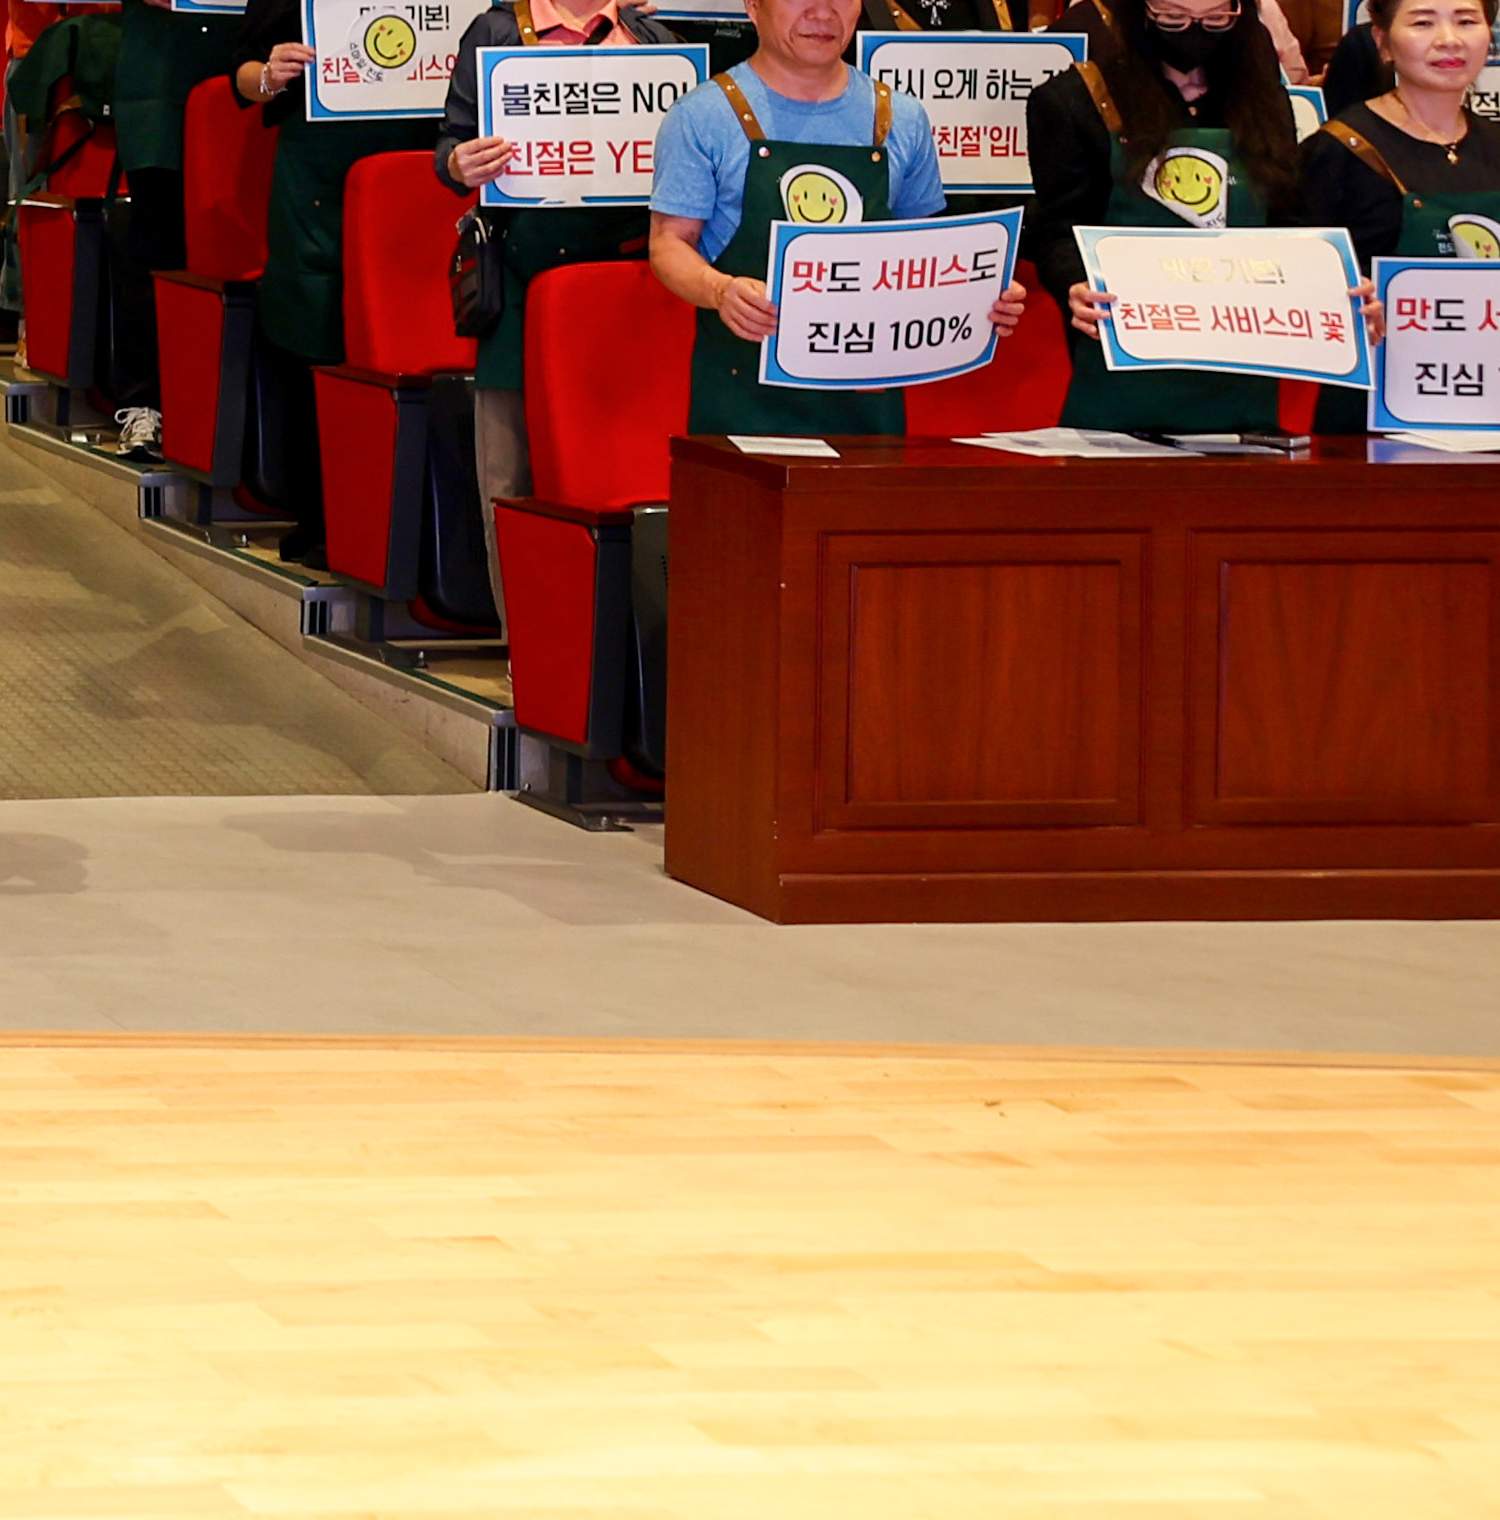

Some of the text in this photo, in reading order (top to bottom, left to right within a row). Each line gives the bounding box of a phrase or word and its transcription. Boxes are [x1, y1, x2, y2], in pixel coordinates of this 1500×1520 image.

[405, 5, 449, 31] 기본!
[502, 82, 621, 115] 불친절은
[933, 69, 1031, 100] 오게 하는
[793, 249, 998, 293] 맛도 서비스도
[1120, 303, 1345, 343] 친절은 서비스의 꽃
[1397, 298, 1466, 331] 맛도
[808, 313, 972, 353] 진심 100%
[1415, 363, 1483, 396] 진심
